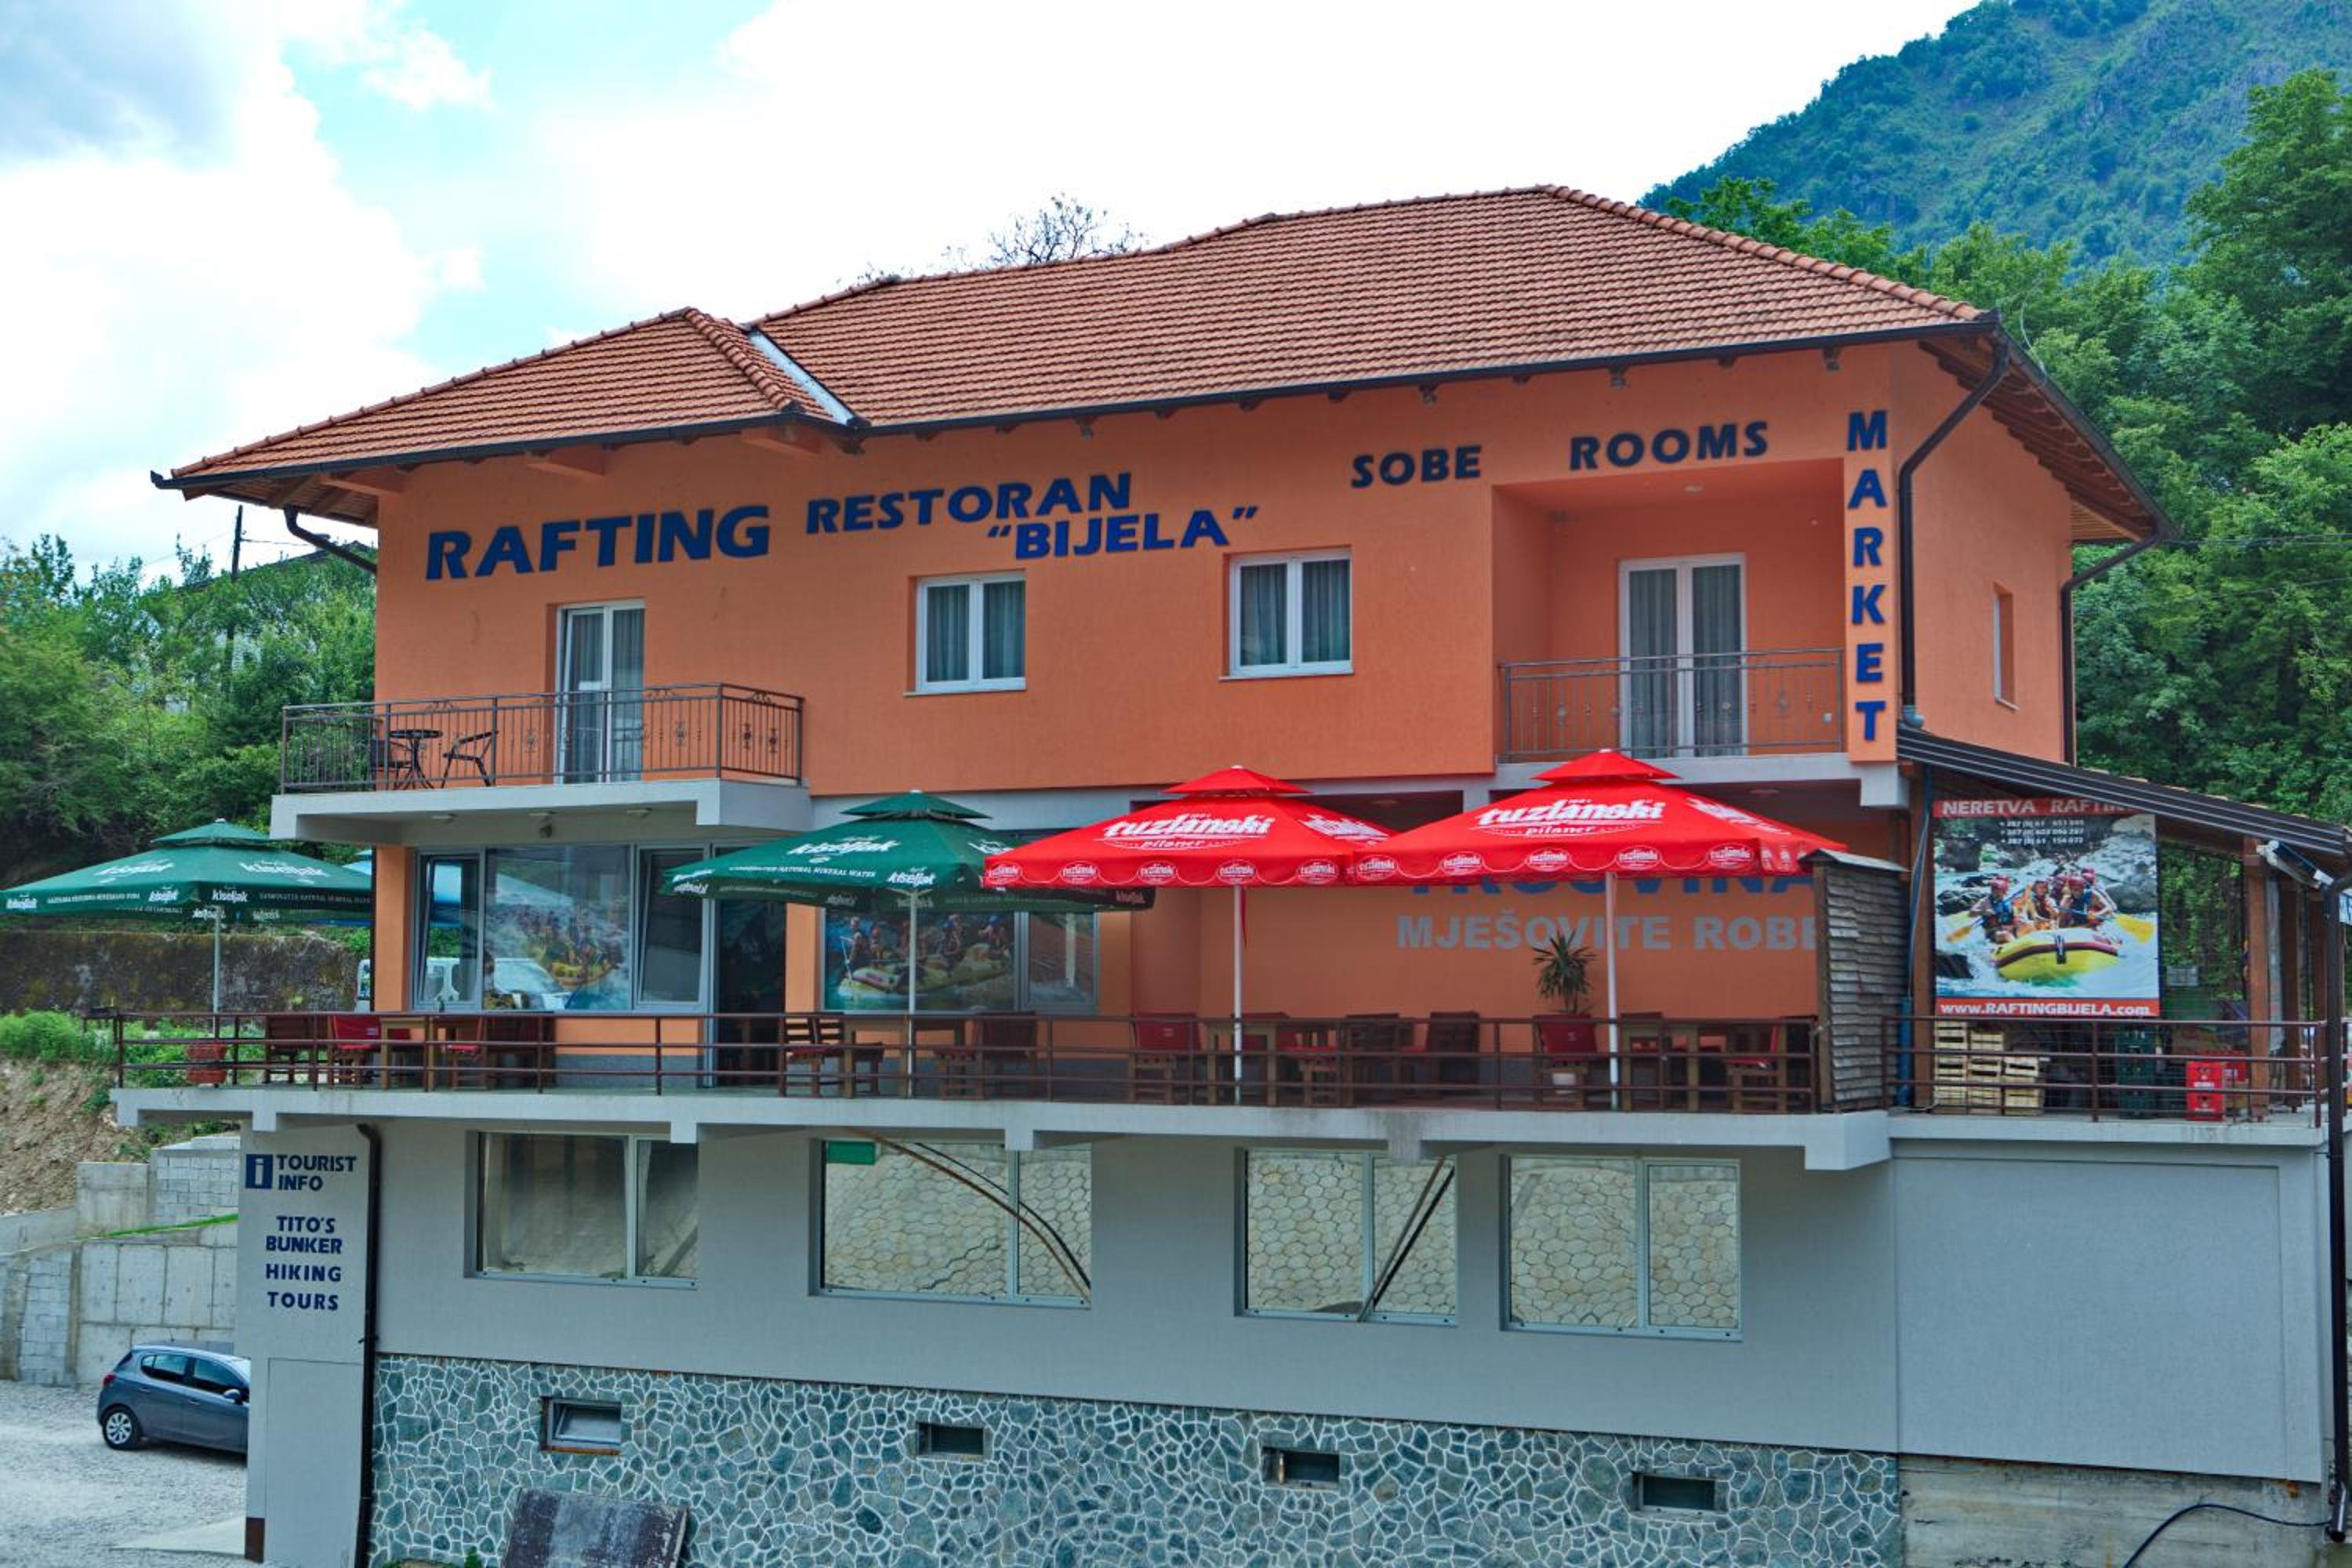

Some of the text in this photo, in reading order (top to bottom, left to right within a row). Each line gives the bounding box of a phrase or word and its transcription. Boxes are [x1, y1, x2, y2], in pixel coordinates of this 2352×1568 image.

[1570, 421, 1769, 471] ROOMS
[1352, 445, 1482, 488] SOBE
[806, 472, 1131, 535] RESTORAN
[425, 505, 770, 580] RAFTING
[1848, 410, 1889, 742] MARKET
[1475, 799, 1666, 826] tuzlanski
[1942, 800, 2036, 815] NERETVA
[1103, 813, 1276, 837] tuzlanski
[1396, 907, 1670, 952] MJEŠOVITE
[276, 1154, 357, 1173] TOURIST
[278, 1174, 324, 1192] INFO
[276, 1215, 336, 1234] TITO'S
[266, 1235, 343, 1254] BUNKER
[266, 1263, 342, 1283] HIKING
[267, 1291, 339, 1311] TOURS
